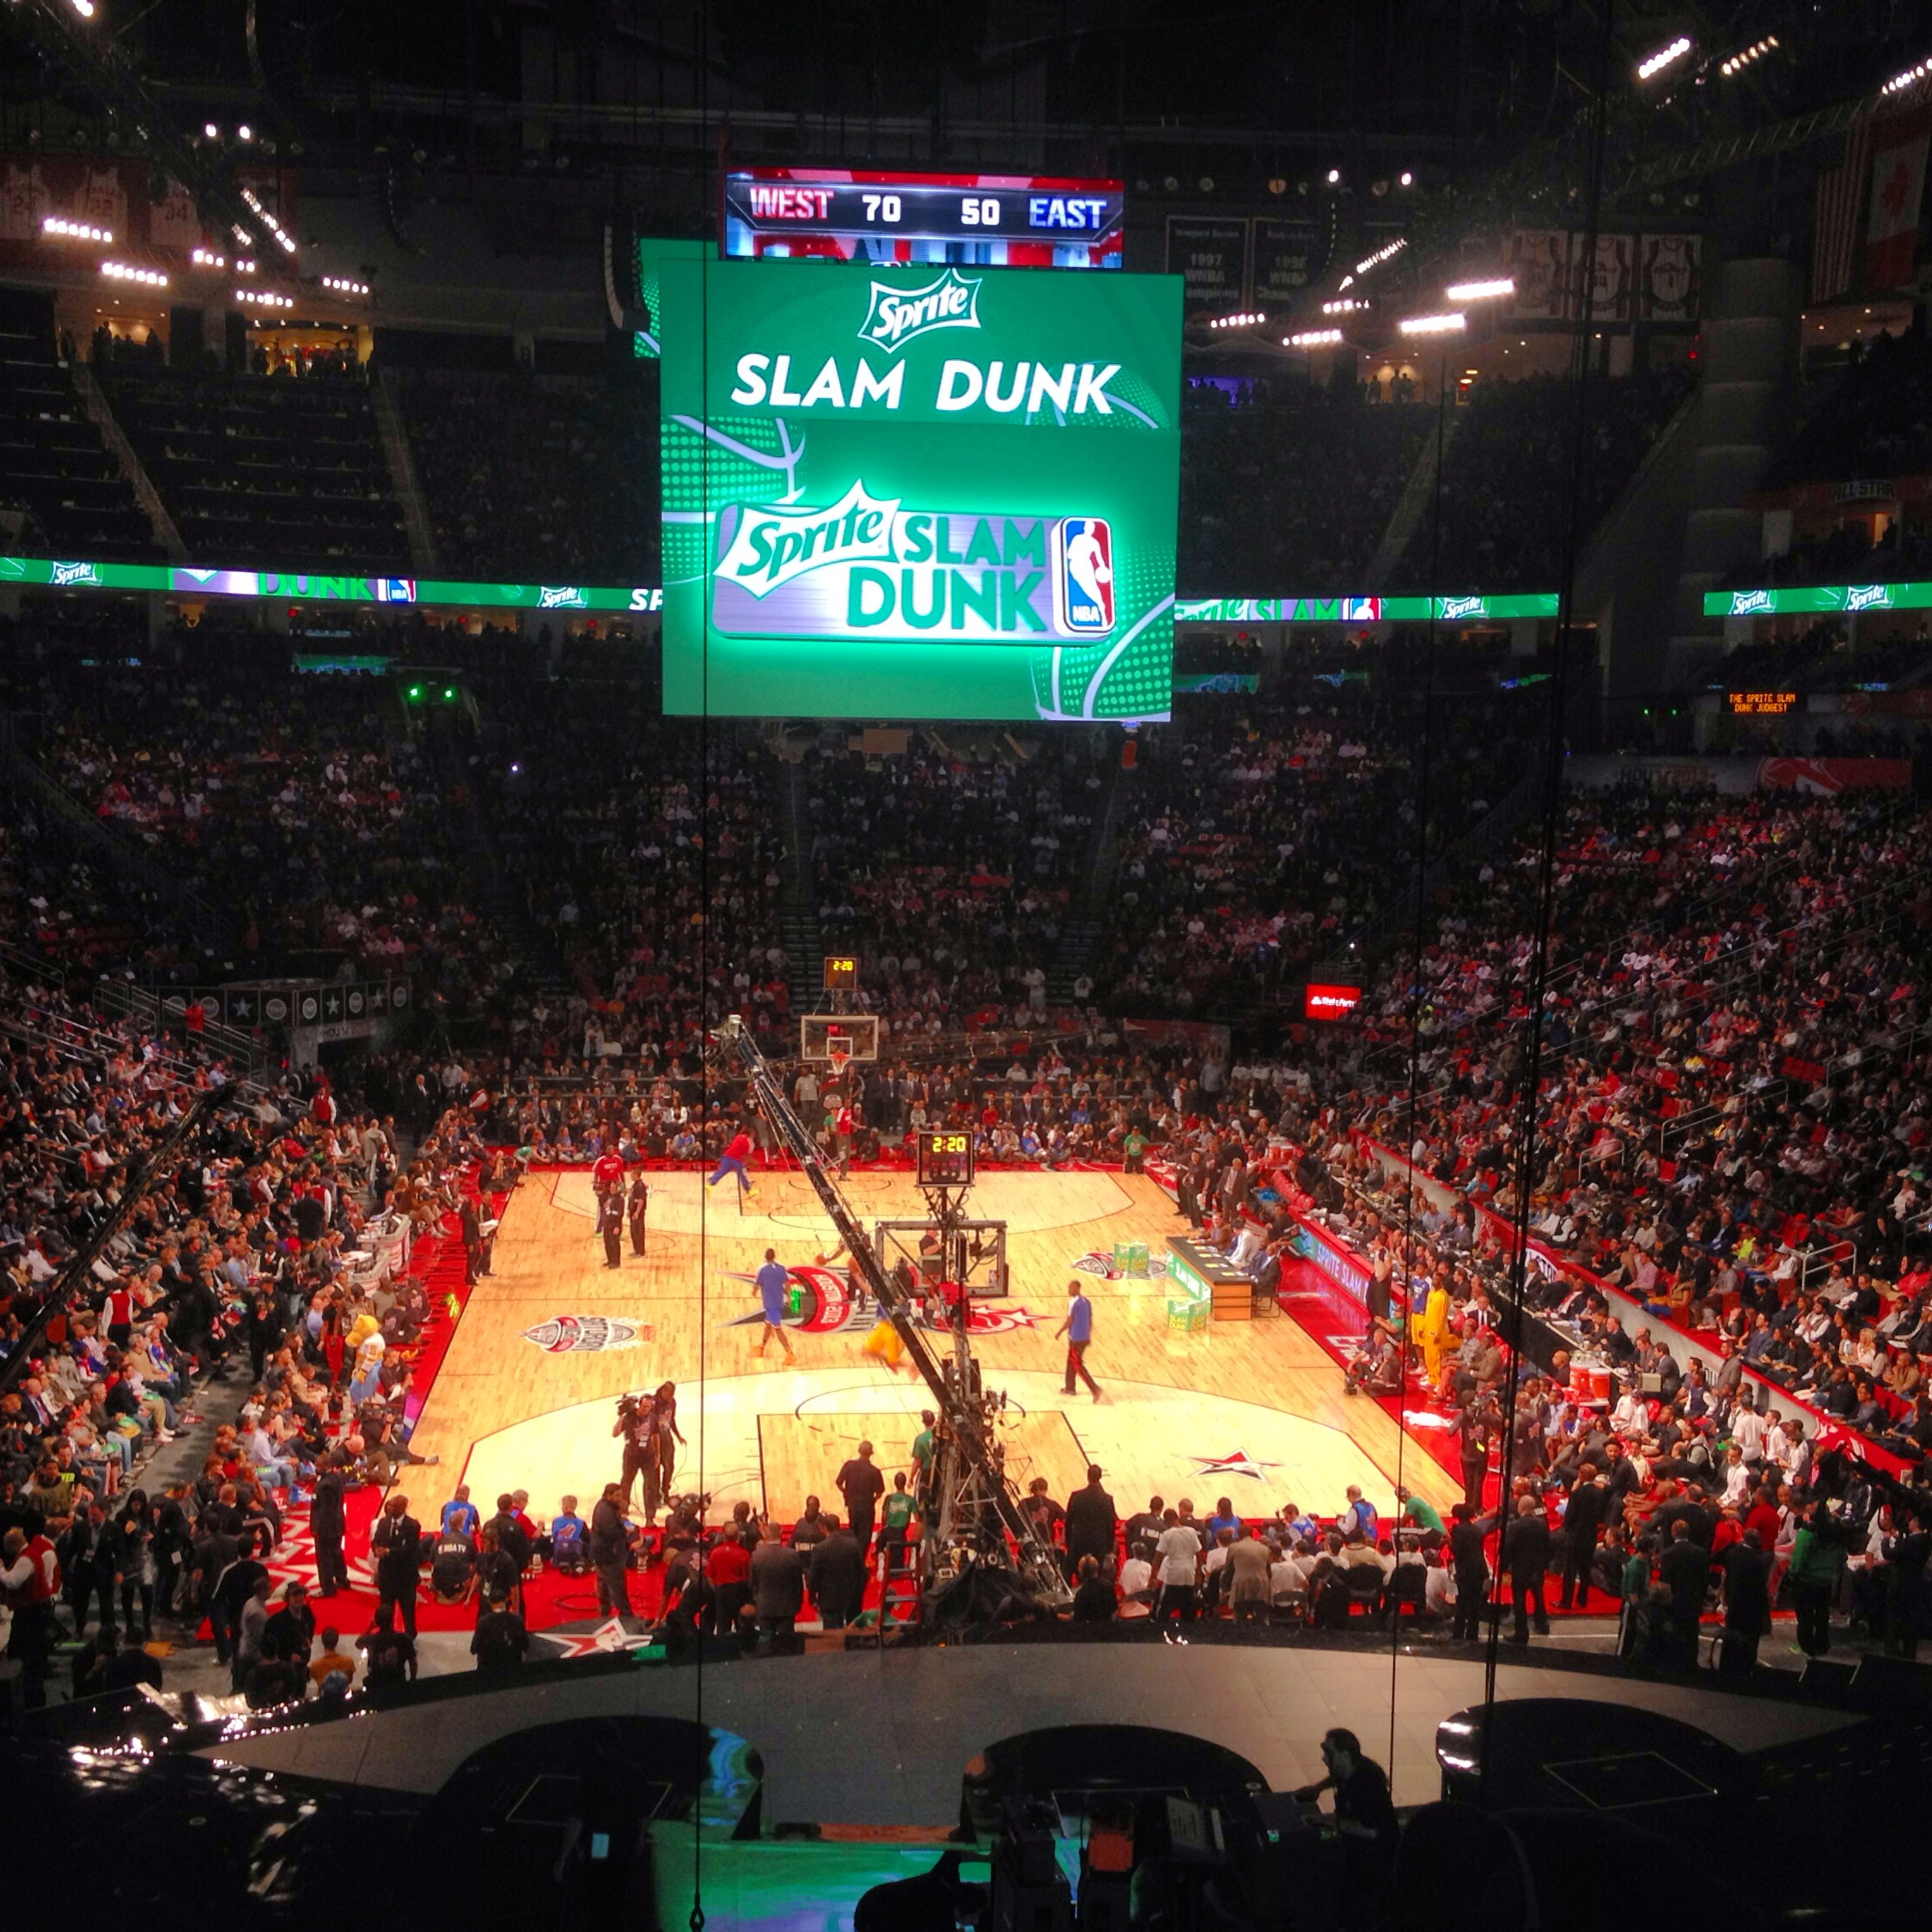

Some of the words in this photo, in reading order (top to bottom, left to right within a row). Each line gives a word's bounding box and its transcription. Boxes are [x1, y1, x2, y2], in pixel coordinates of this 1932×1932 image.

[750, 187, 834, 218] WEST
[862, 194, 901, 222] 70
[960, 198, 1000, 226] 50
[1029, 198, 1107, 229] EAST
[871, 280, 968, 340] Sprite
[731, 355, 906, 410] SLAM
[936, 359, 1122, 414] DUNK
[736, 501, 886, 582] Sprite
[903, 516, 1046, 566] SLAM
[55, 562, 92, 584] Sprite
[543, 588, 578, 608] Sprite
[847, 568, 1047, 632] DUNK
[1444, 599, 1483, 619] Sprite
[1734, 589, 1767, 614] Sprite
[1848, 584, 1885, 611] Sprite
[1072, 605, 1100, 623] NBA
[1729, 693, 1743, 703] THE
[833, 960, 853, 971] 2:20
[932, 1137, 966, 1153] 2:20
[1316, 1242, 1340, 1278] SPRITE
[1342, 1264, 1362, 1297] SLAM
